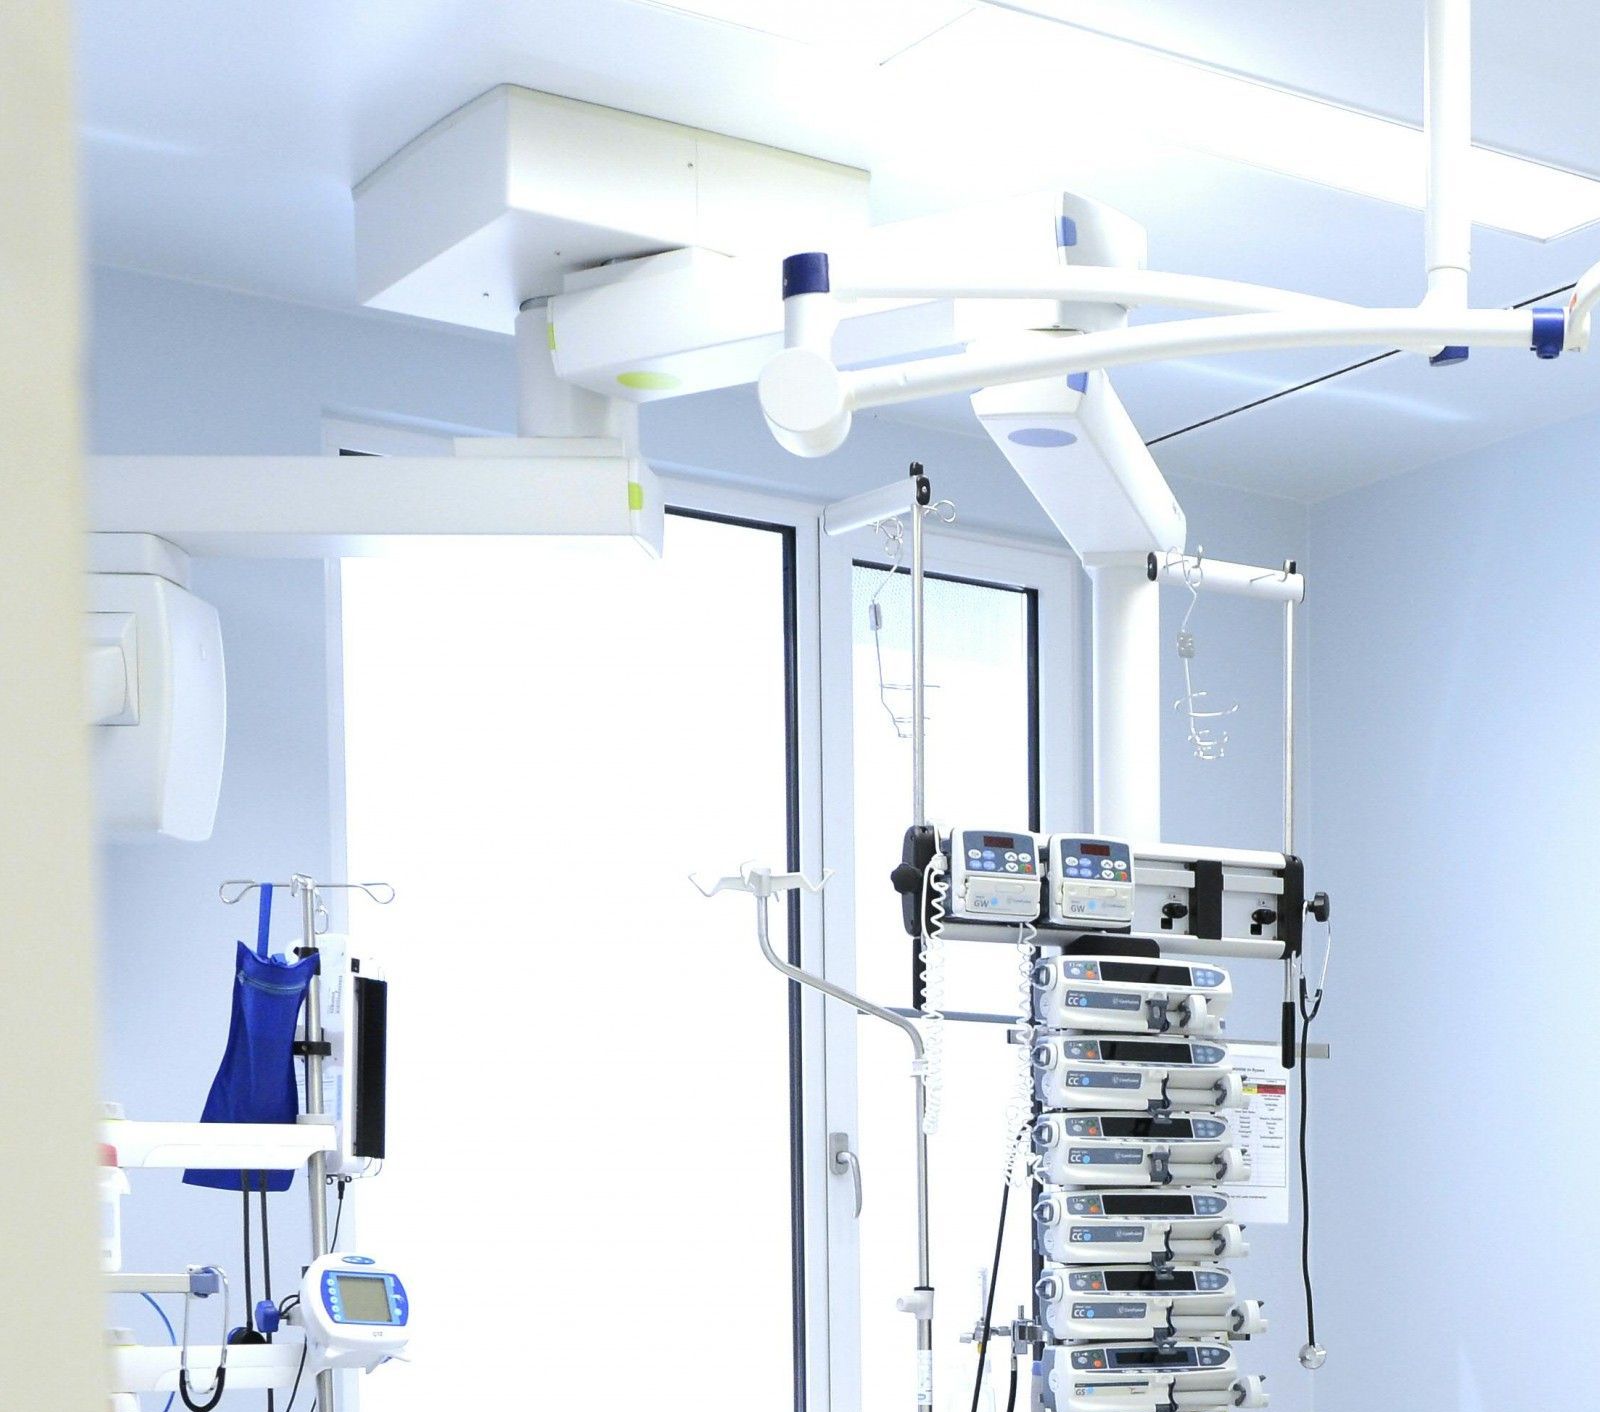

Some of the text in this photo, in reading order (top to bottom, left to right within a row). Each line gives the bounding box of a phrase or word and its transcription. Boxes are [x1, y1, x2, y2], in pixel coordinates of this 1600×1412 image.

[1070, 904, 1085, 913] GW
[1067, 997, 1079, 1005] CC
[1068, 1077, 1079, 1085] CC
[1070, 1154, 1081, 1162] CC
[1071, 1232, 1083, 1241] CC
[1074, 1309, 1085, 1317] CC
